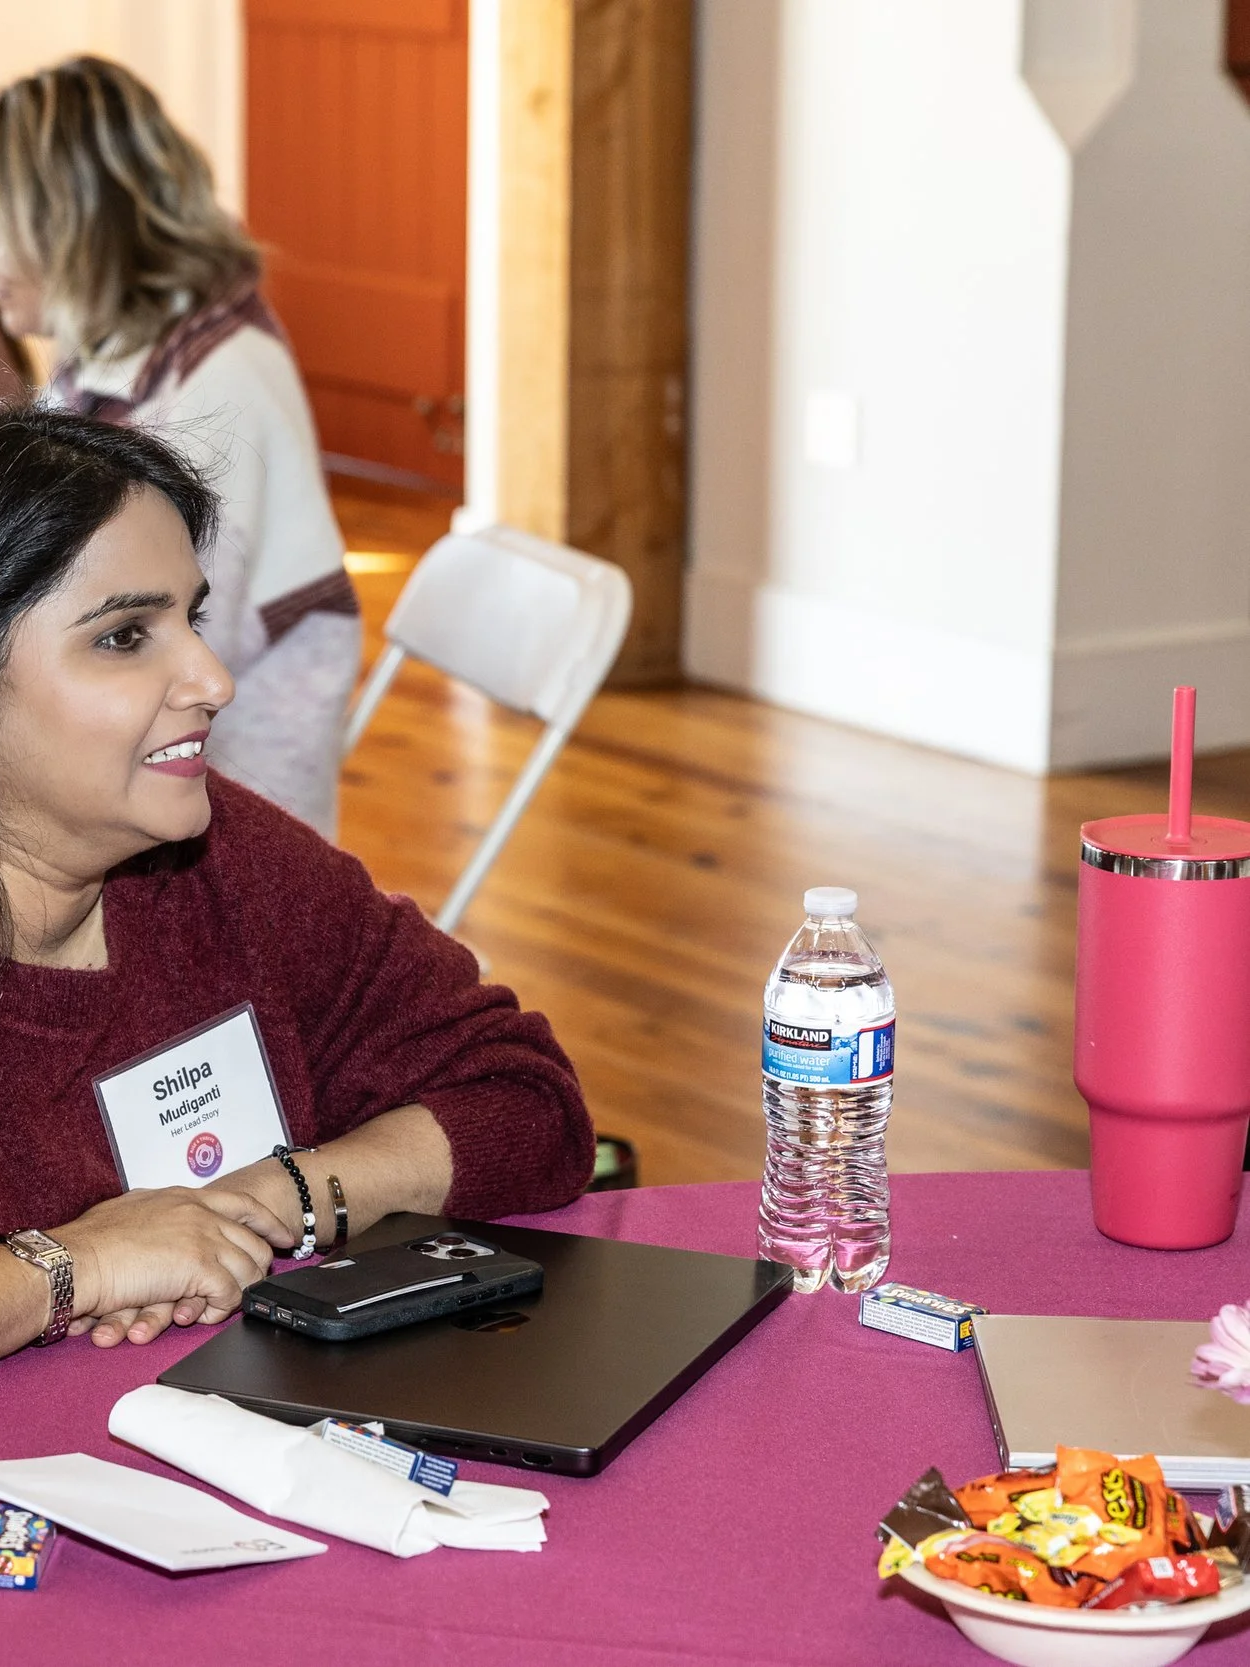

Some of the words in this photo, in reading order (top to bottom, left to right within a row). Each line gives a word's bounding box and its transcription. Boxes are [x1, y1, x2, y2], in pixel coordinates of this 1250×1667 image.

[771, 1022, 830, 1043] KIRKLAND
[771, 1034, 829, 1048] Signature
[768, 1048, 797, 1064] purified
[799, 1055, 831, 1067] water
[152, 1060, 213, 1101] Shilpa
[158, 1084, 221, 1126] Mudiganti
[170, 1126, 184, 1138] Her
[184, 1118, 201, 1132] Lead
[201, 1108, 220, 1125] Story
[886, 1288, 973, 1315] Smarties
